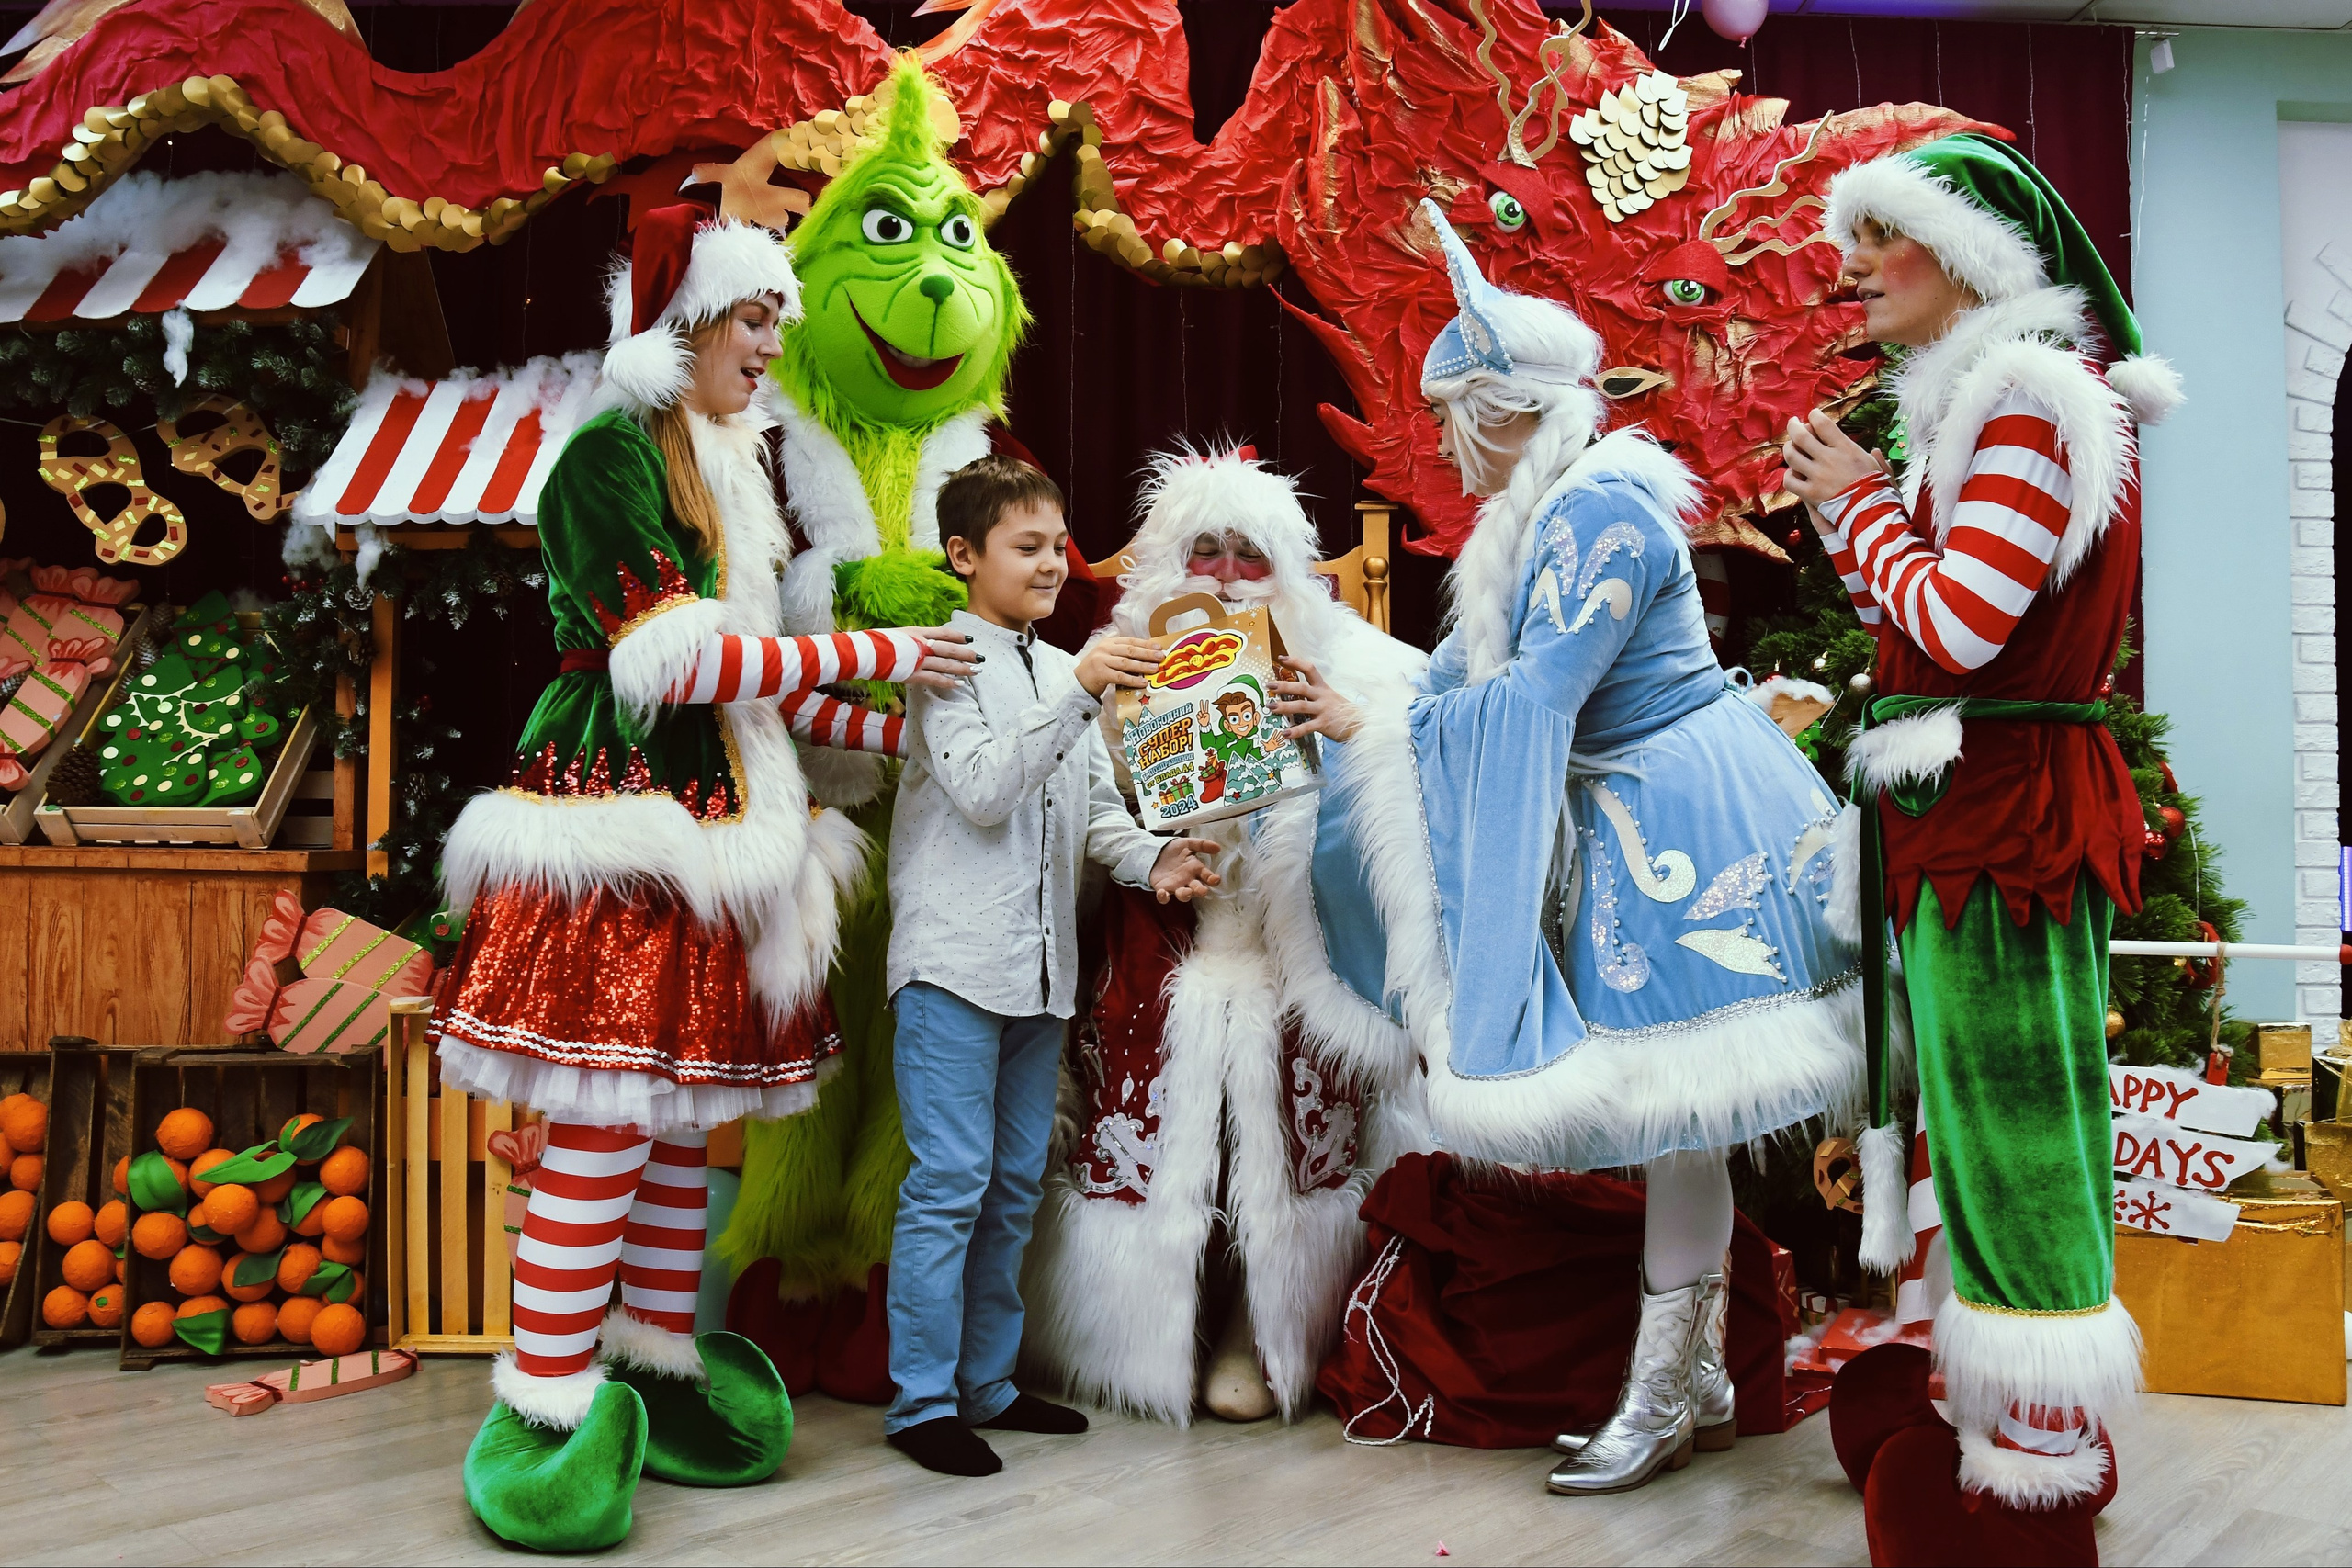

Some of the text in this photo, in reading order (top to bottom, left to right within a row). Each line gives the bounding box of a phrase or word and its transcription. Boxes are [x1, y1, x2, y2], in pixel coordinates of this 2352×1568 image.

[1129, 703, 1193, 746] НОВОГОДНИЙ
[1138, 716, 1193, 757] СУПЕР
[1137, 732, 1193, 771] НАБОР!
[1154, 766, 1182, 784] ВЛАДА
[1160, 795, 1200, 818] 2024
[2113, 1131, 2235, 1188] DAYS
